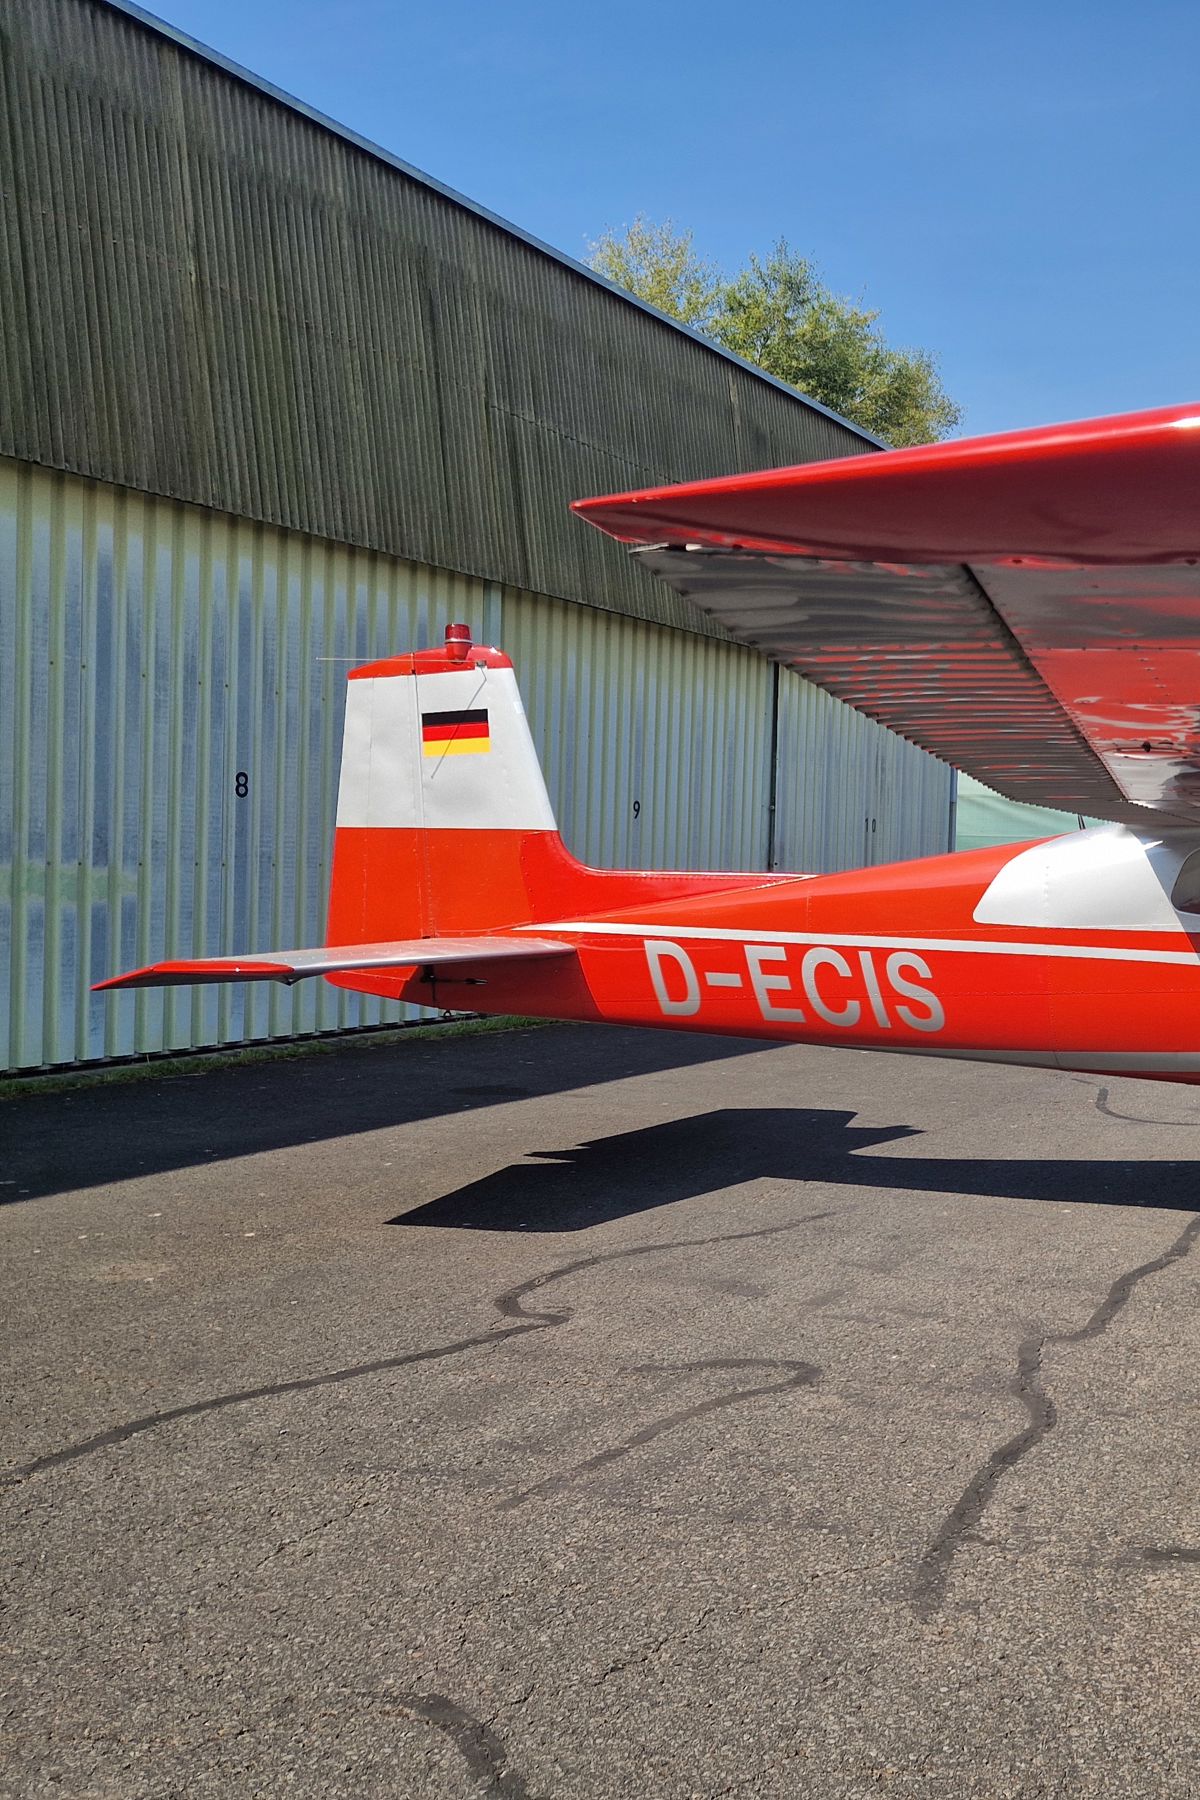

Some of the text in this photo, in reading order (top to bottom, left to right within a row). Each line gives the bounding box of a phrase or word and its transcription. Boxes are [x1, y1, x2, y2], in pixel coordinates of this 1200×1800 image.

[235, 771, 249, 798] 8
[633, 800, 641, 820] 9
[865, 817, 877, 833] 10
[643, 939, 946, 1033] D-ECIS
